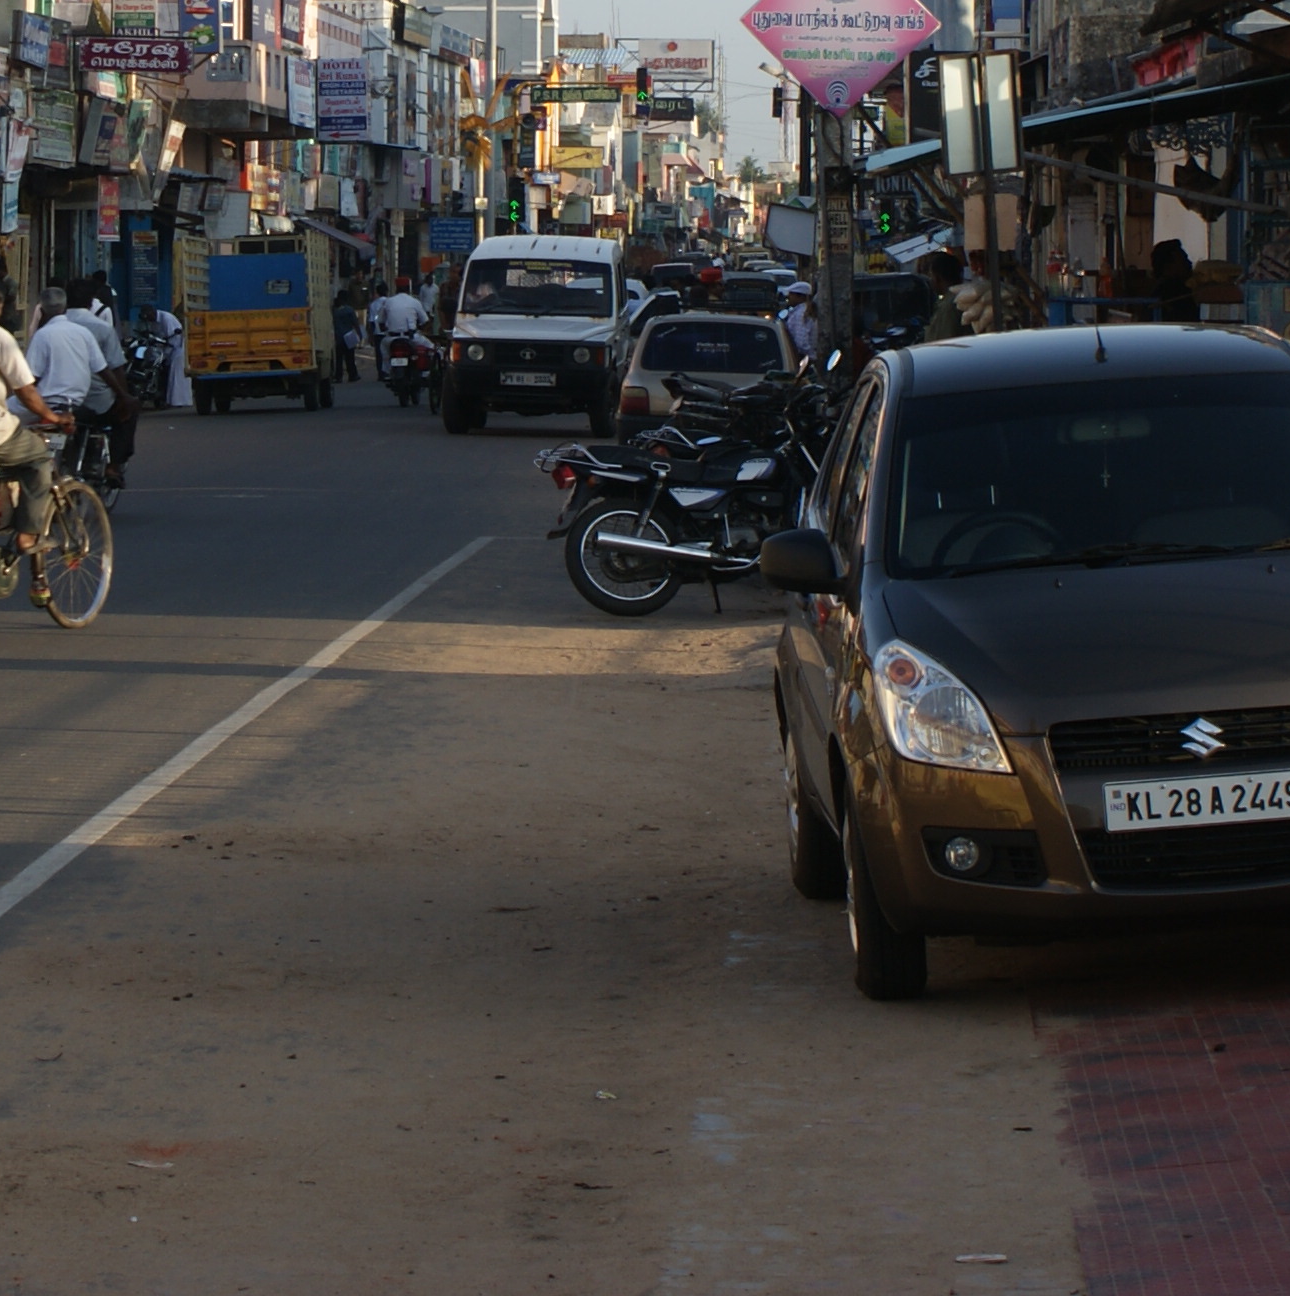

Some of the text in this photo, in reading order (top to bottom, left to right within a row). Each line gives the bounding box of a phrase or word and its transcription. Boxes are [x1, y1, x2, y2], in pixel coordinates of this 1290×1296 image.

[753, 11, 793, 31] புதுவை
[91, 42, 179, 58] சுரேஷ்
[323, 61, 362, 70] HOTEL
[1126, 790, 1162, 821] KL
[1168, 788, 1202, 818] 28
[1210, 786, 1224, 815] A
